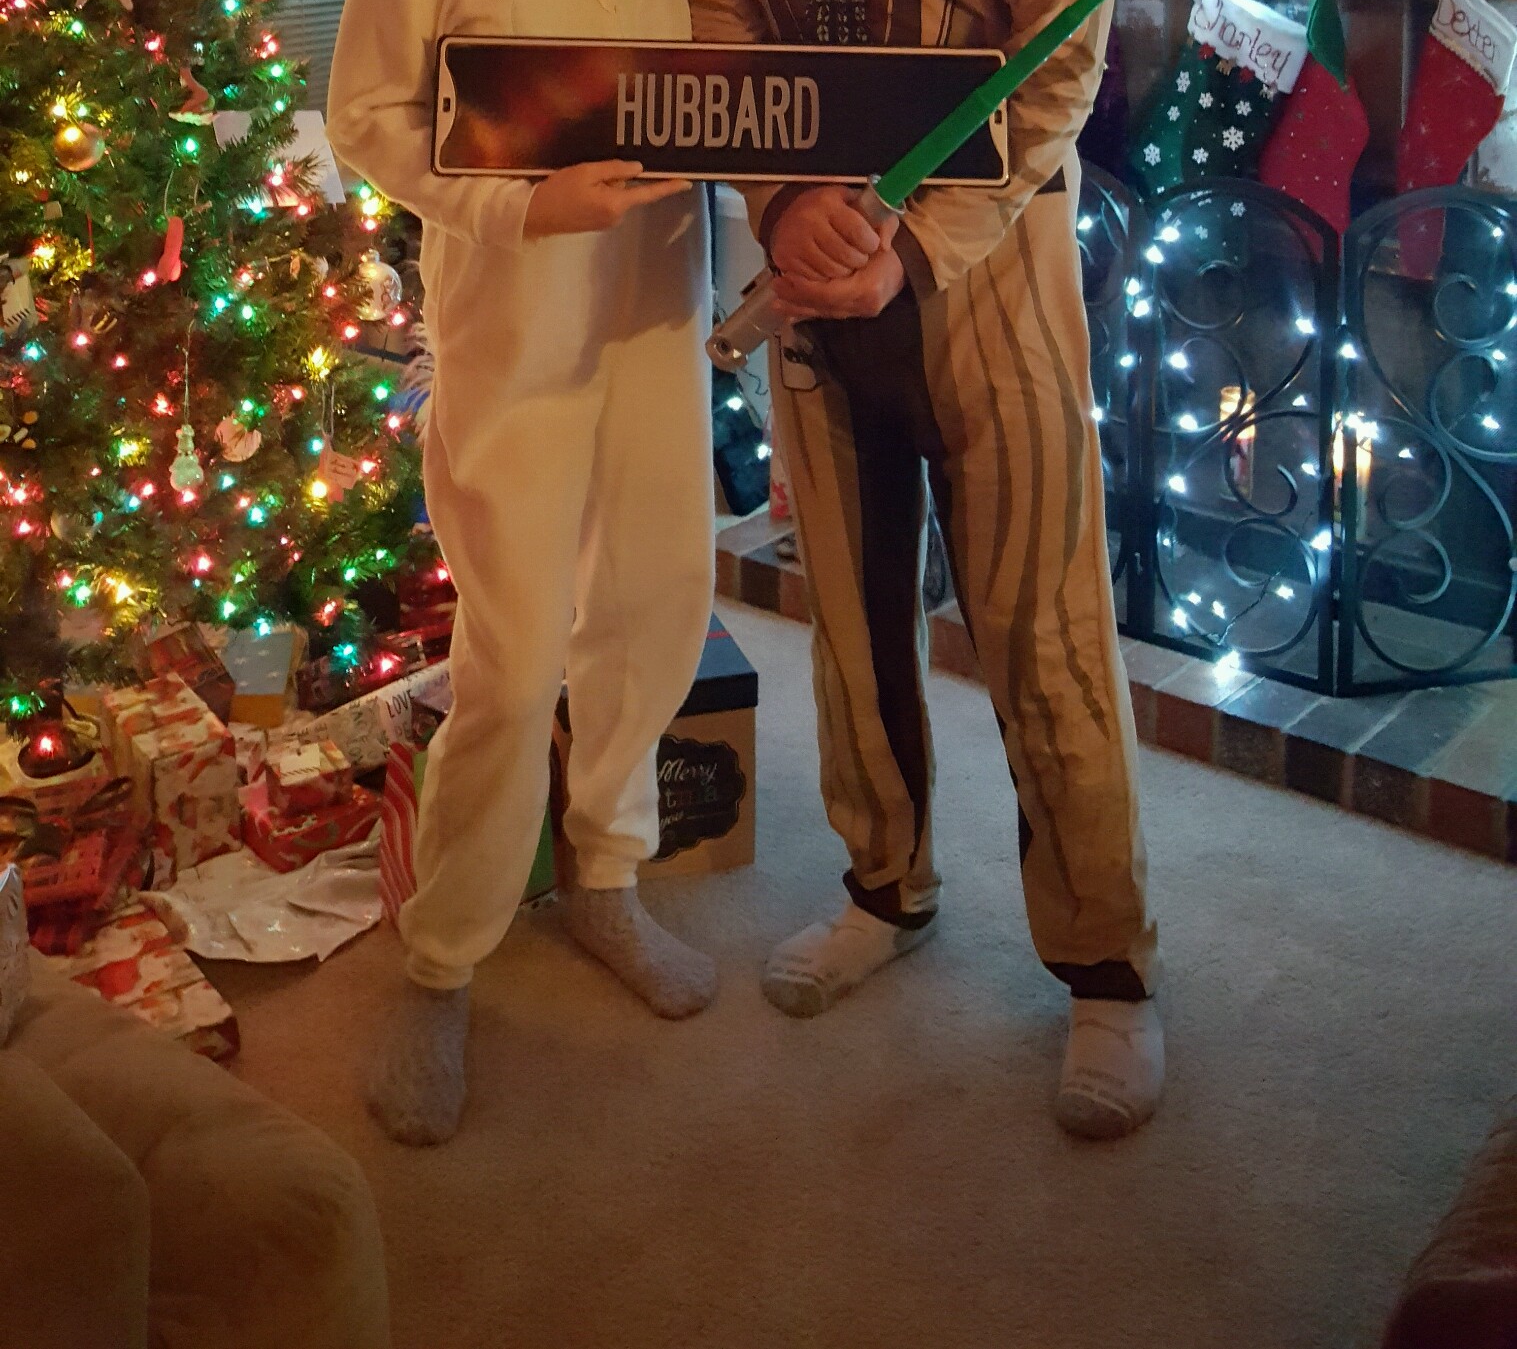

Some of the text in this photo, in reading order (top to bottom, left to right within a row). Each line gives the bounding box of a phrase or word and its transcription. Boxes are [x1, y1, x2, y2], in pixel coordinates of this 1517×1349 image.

[616, 72, 820, 150] HUBBARD
[385, 689, 415, 719] LOVE
[657, 758, 718, 787] Merry
